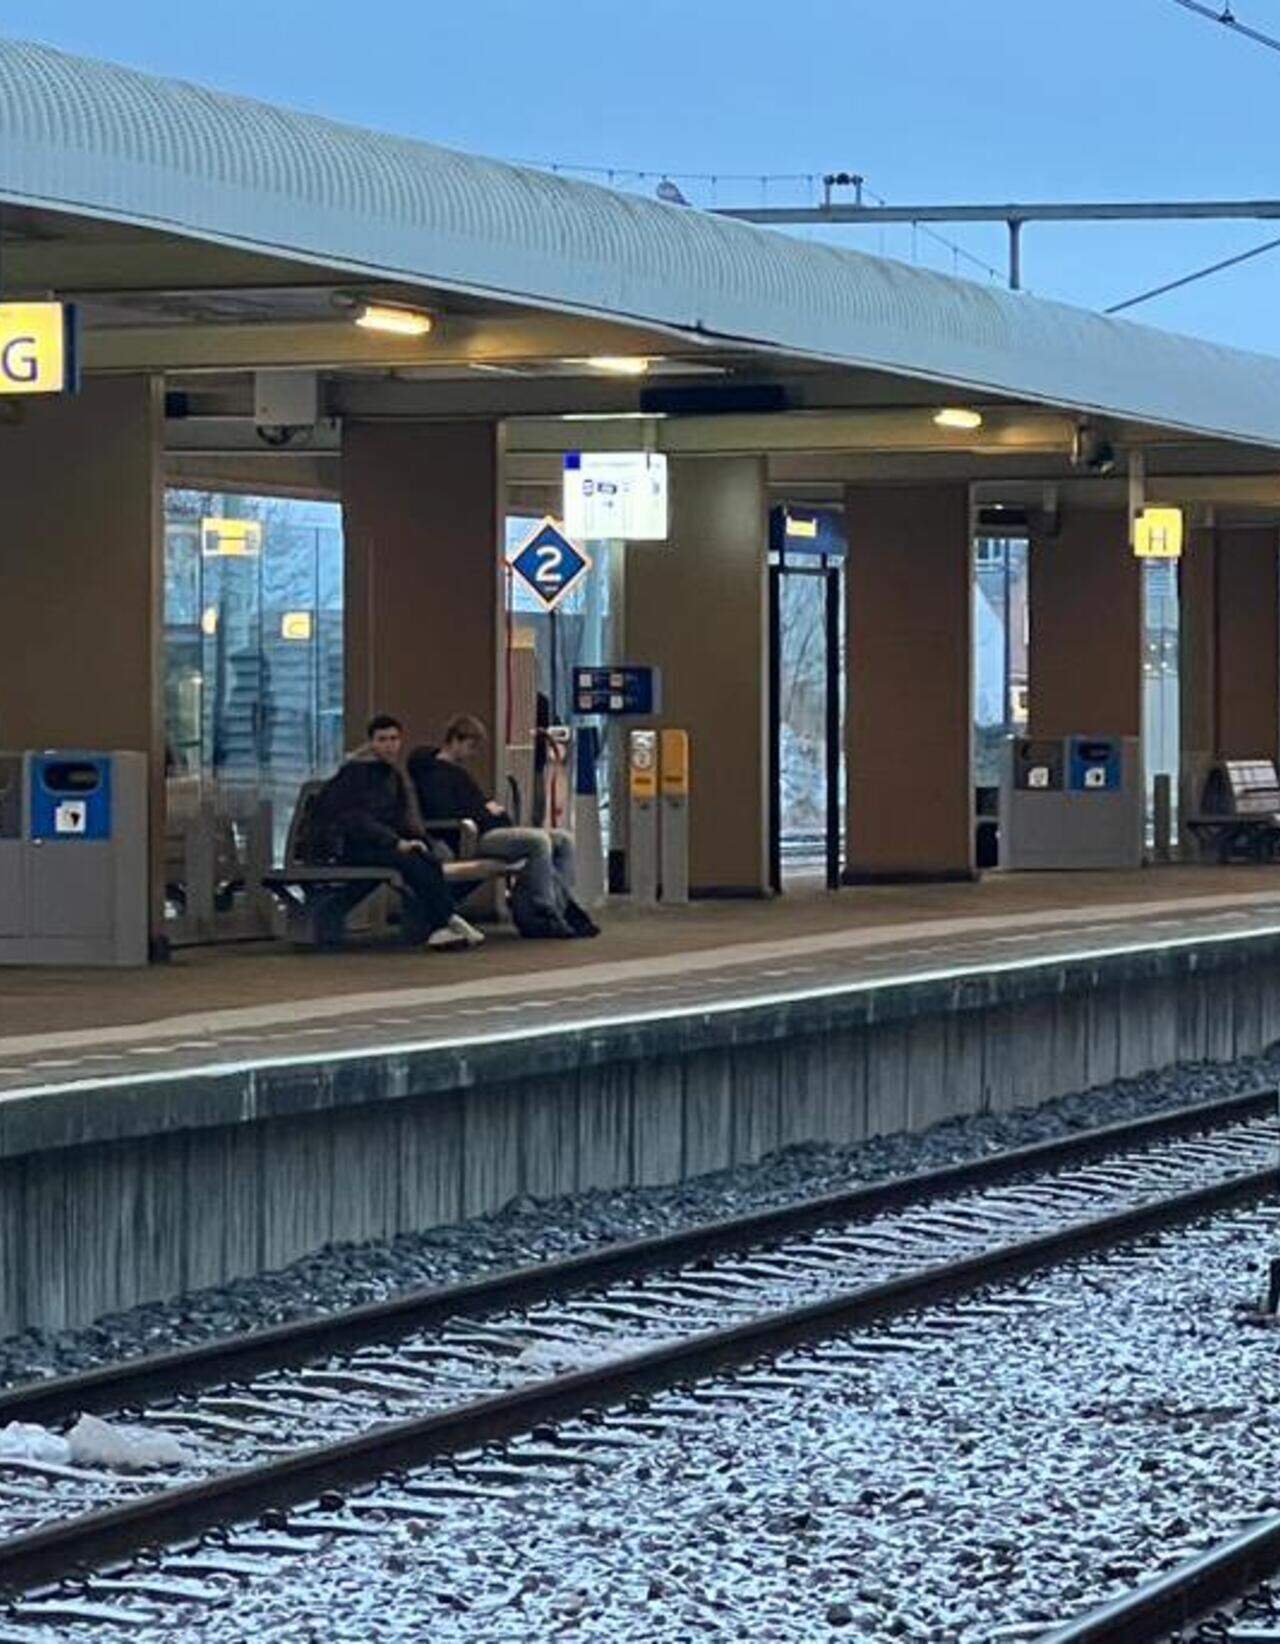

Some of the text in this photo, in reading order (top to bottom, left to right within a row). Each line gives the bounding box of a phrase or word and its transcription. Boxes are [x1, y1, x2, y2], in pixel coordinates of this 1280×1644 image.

[1, 337, 38, 382] G
[1148, 525, 1167, 552] H
[536, 545, 562, 581] 2
